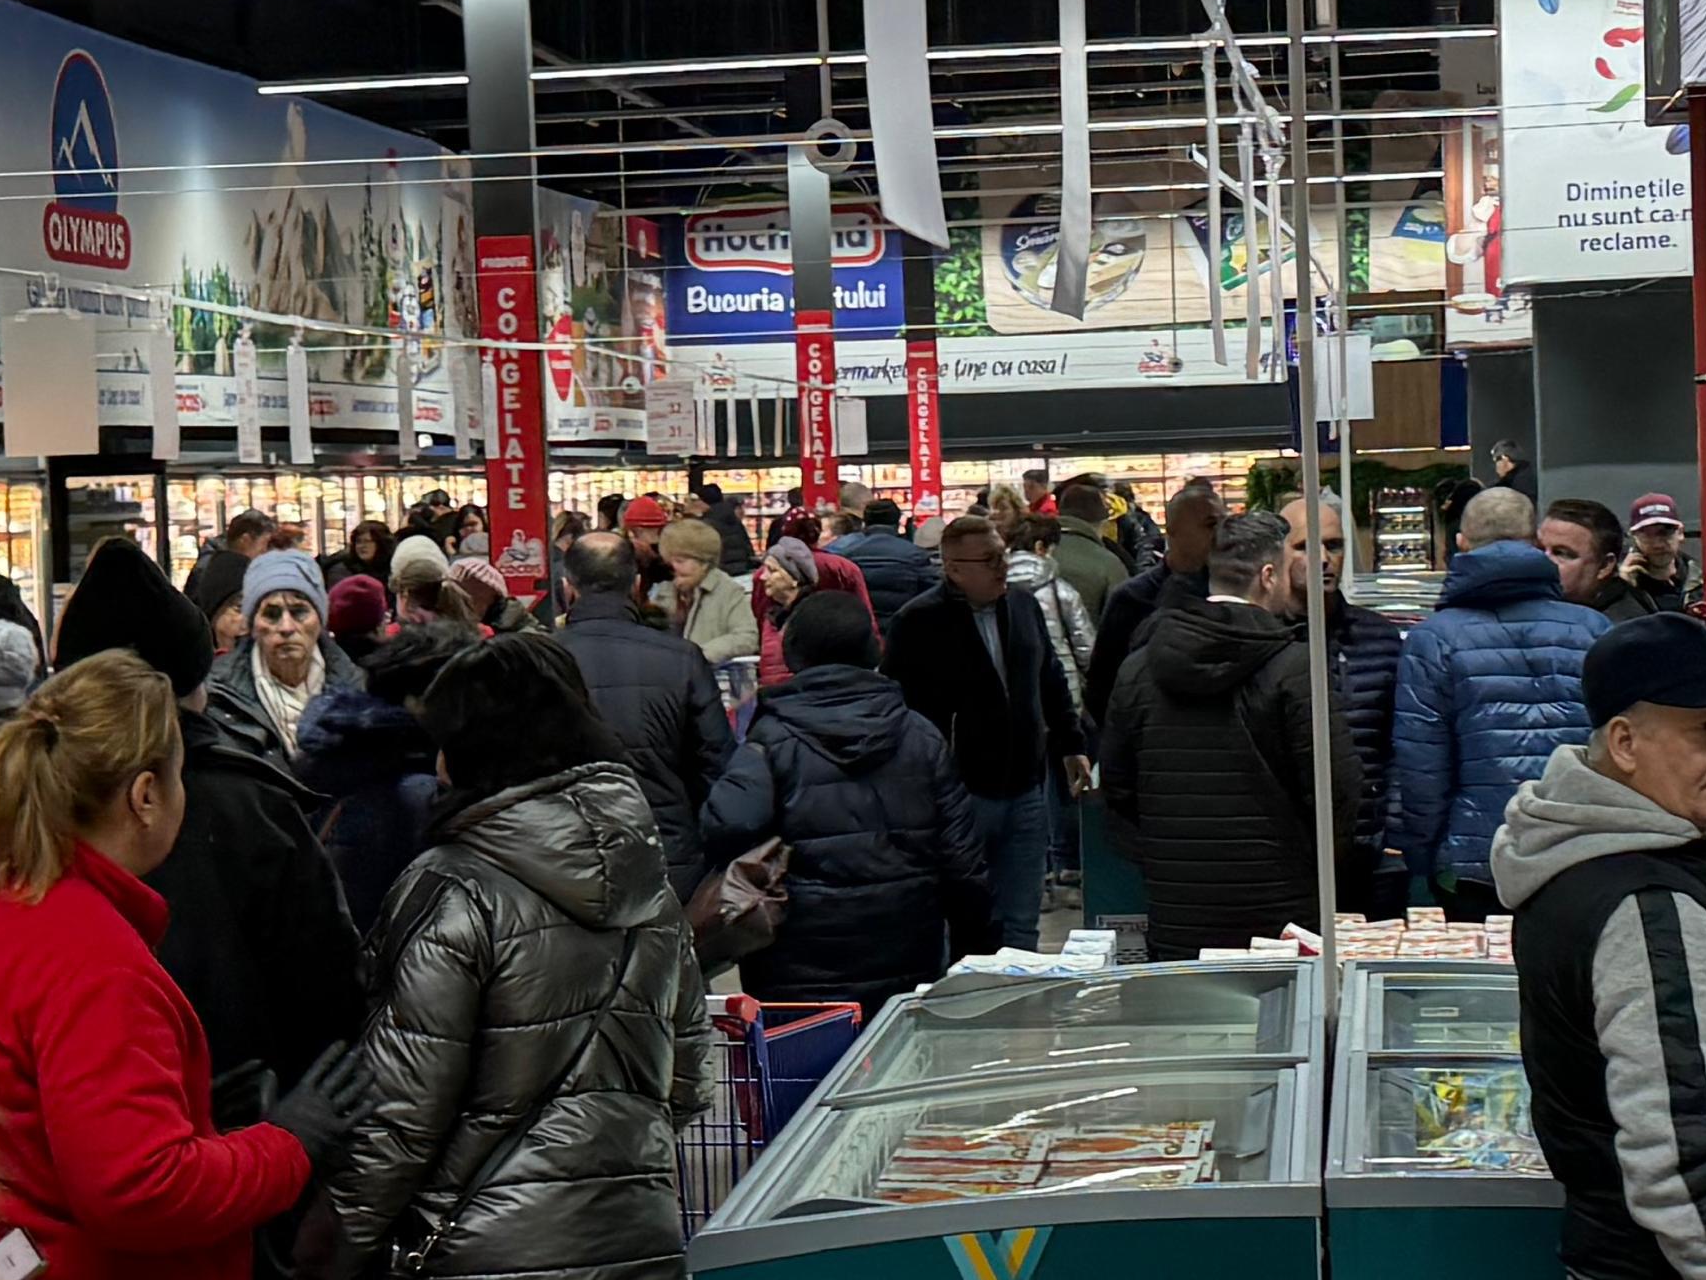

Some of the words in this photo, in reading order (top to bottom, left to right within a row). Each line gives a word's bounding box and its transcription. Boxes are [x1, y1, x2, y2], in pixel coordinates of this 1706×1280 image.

[1566, 177, 1685, 205] Diminețile
[1558, 210, 1588, 228] nu
[1592, 206, 1645, 226] sunt
[49, 213, 127, 261] OLYMPUS
[1579, 231, 1678, 253] reclame.
[687, 285, 784, 313] Bucuria
[496, 287, 526, 511] CONGELATE
